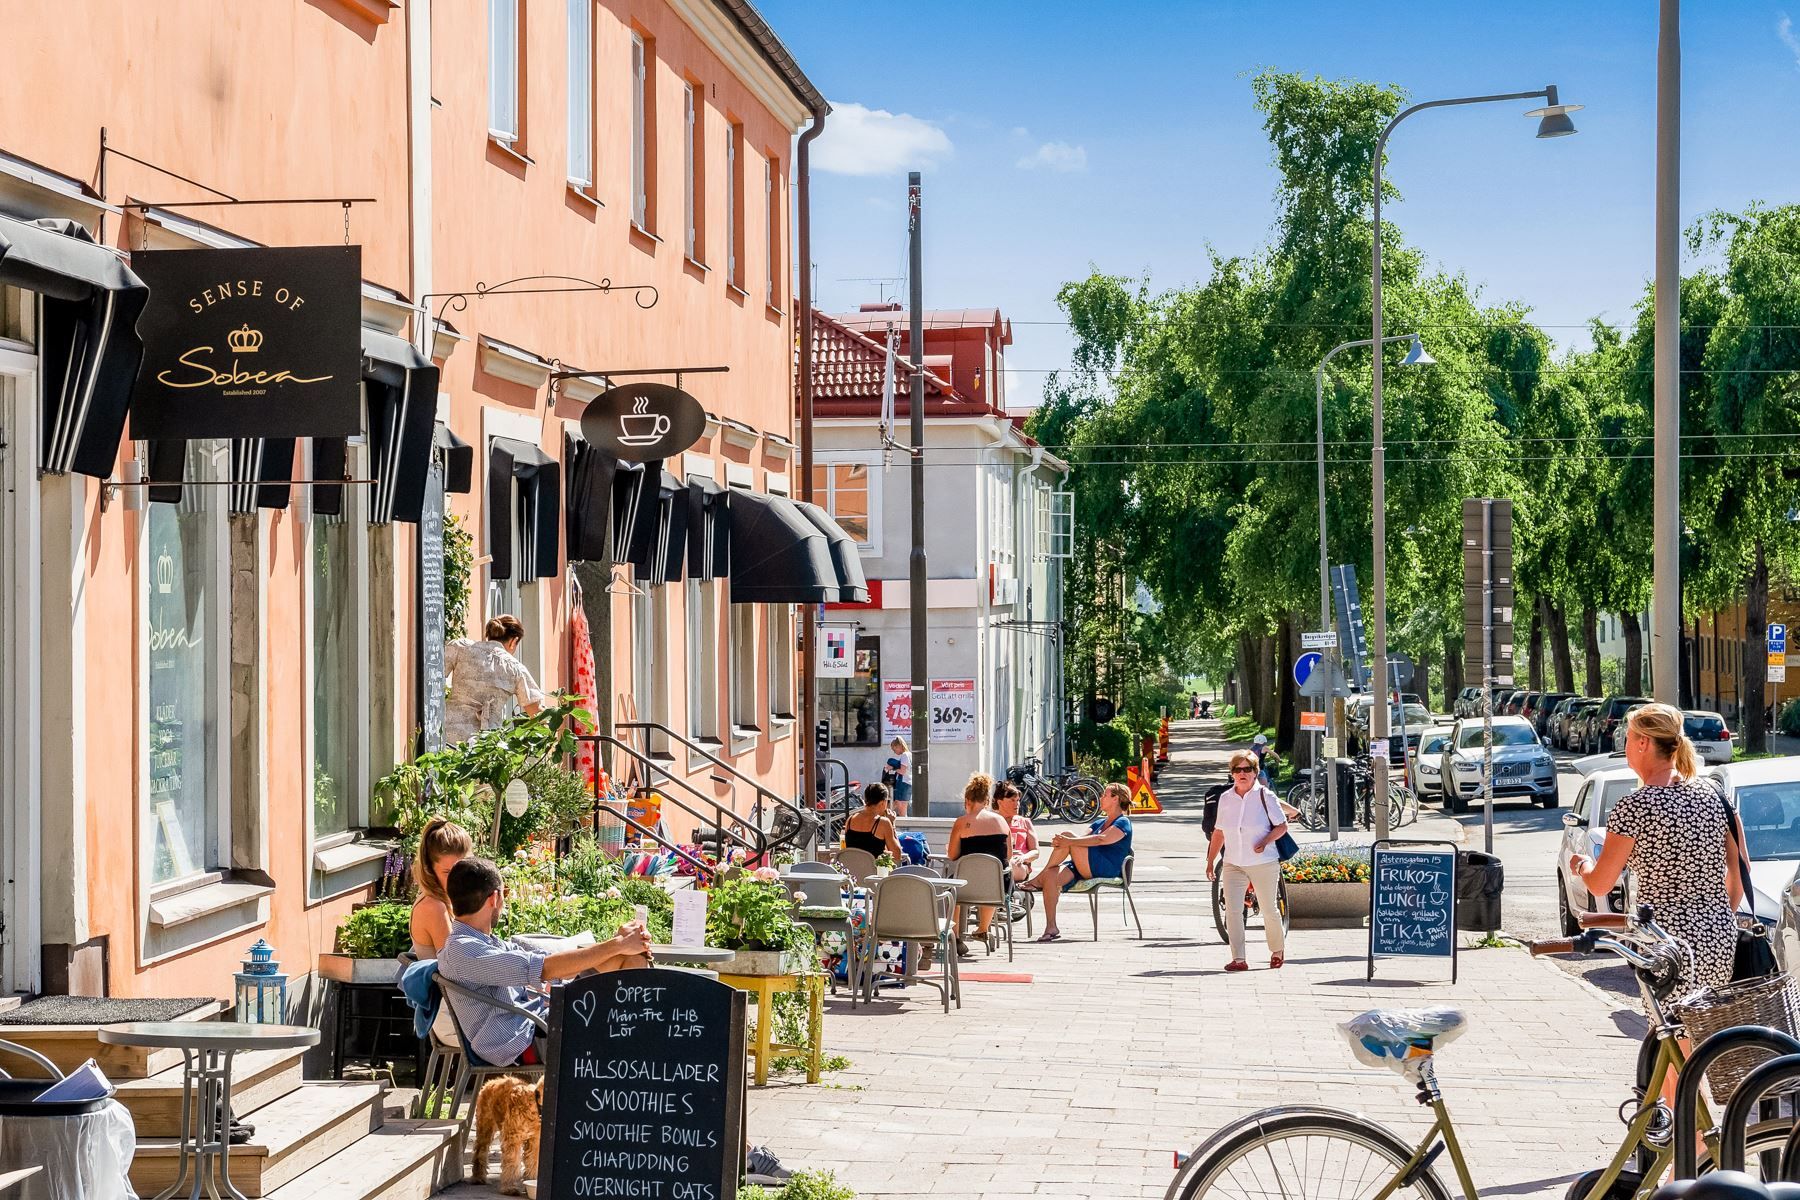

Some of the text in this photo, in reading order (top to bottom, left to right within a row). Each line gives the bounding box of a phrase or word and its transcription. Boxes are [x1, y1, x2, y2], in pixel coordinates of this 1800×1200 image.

[189, 280, 305, 315] SENSE OF
[157, 346, 333, 388] Sobea
[1772, 626, 1783, 640] P
[933, 707, 974, 724] 369:-
[1431, 856, 1441, 864] 15
[1380, 868, 1448, 884] FRUKOST
[1380, 893, 1426, 908] LUNCH
[1380, 924, 1446, 940] FIKA TAKE
[1430, 930, 1448, 942] AWAY
[615, 980, 667, 1003] ÖPPET
[672, 1008, 698, 1022] 11-18
[668, 1025, 704, 1038] 12-15
[574, 1051, 720, 1083] HÄLSOSALLADER
[586, 1088, 694, 1115] SMOOTHIES
[570, 1120, 717, 1148] SMOOTHIE BOWLS
[582, 1150, 690, 1173] CHIAPUDDING
[574, 1175, 715, 1200] OVERNIGHT OATS
